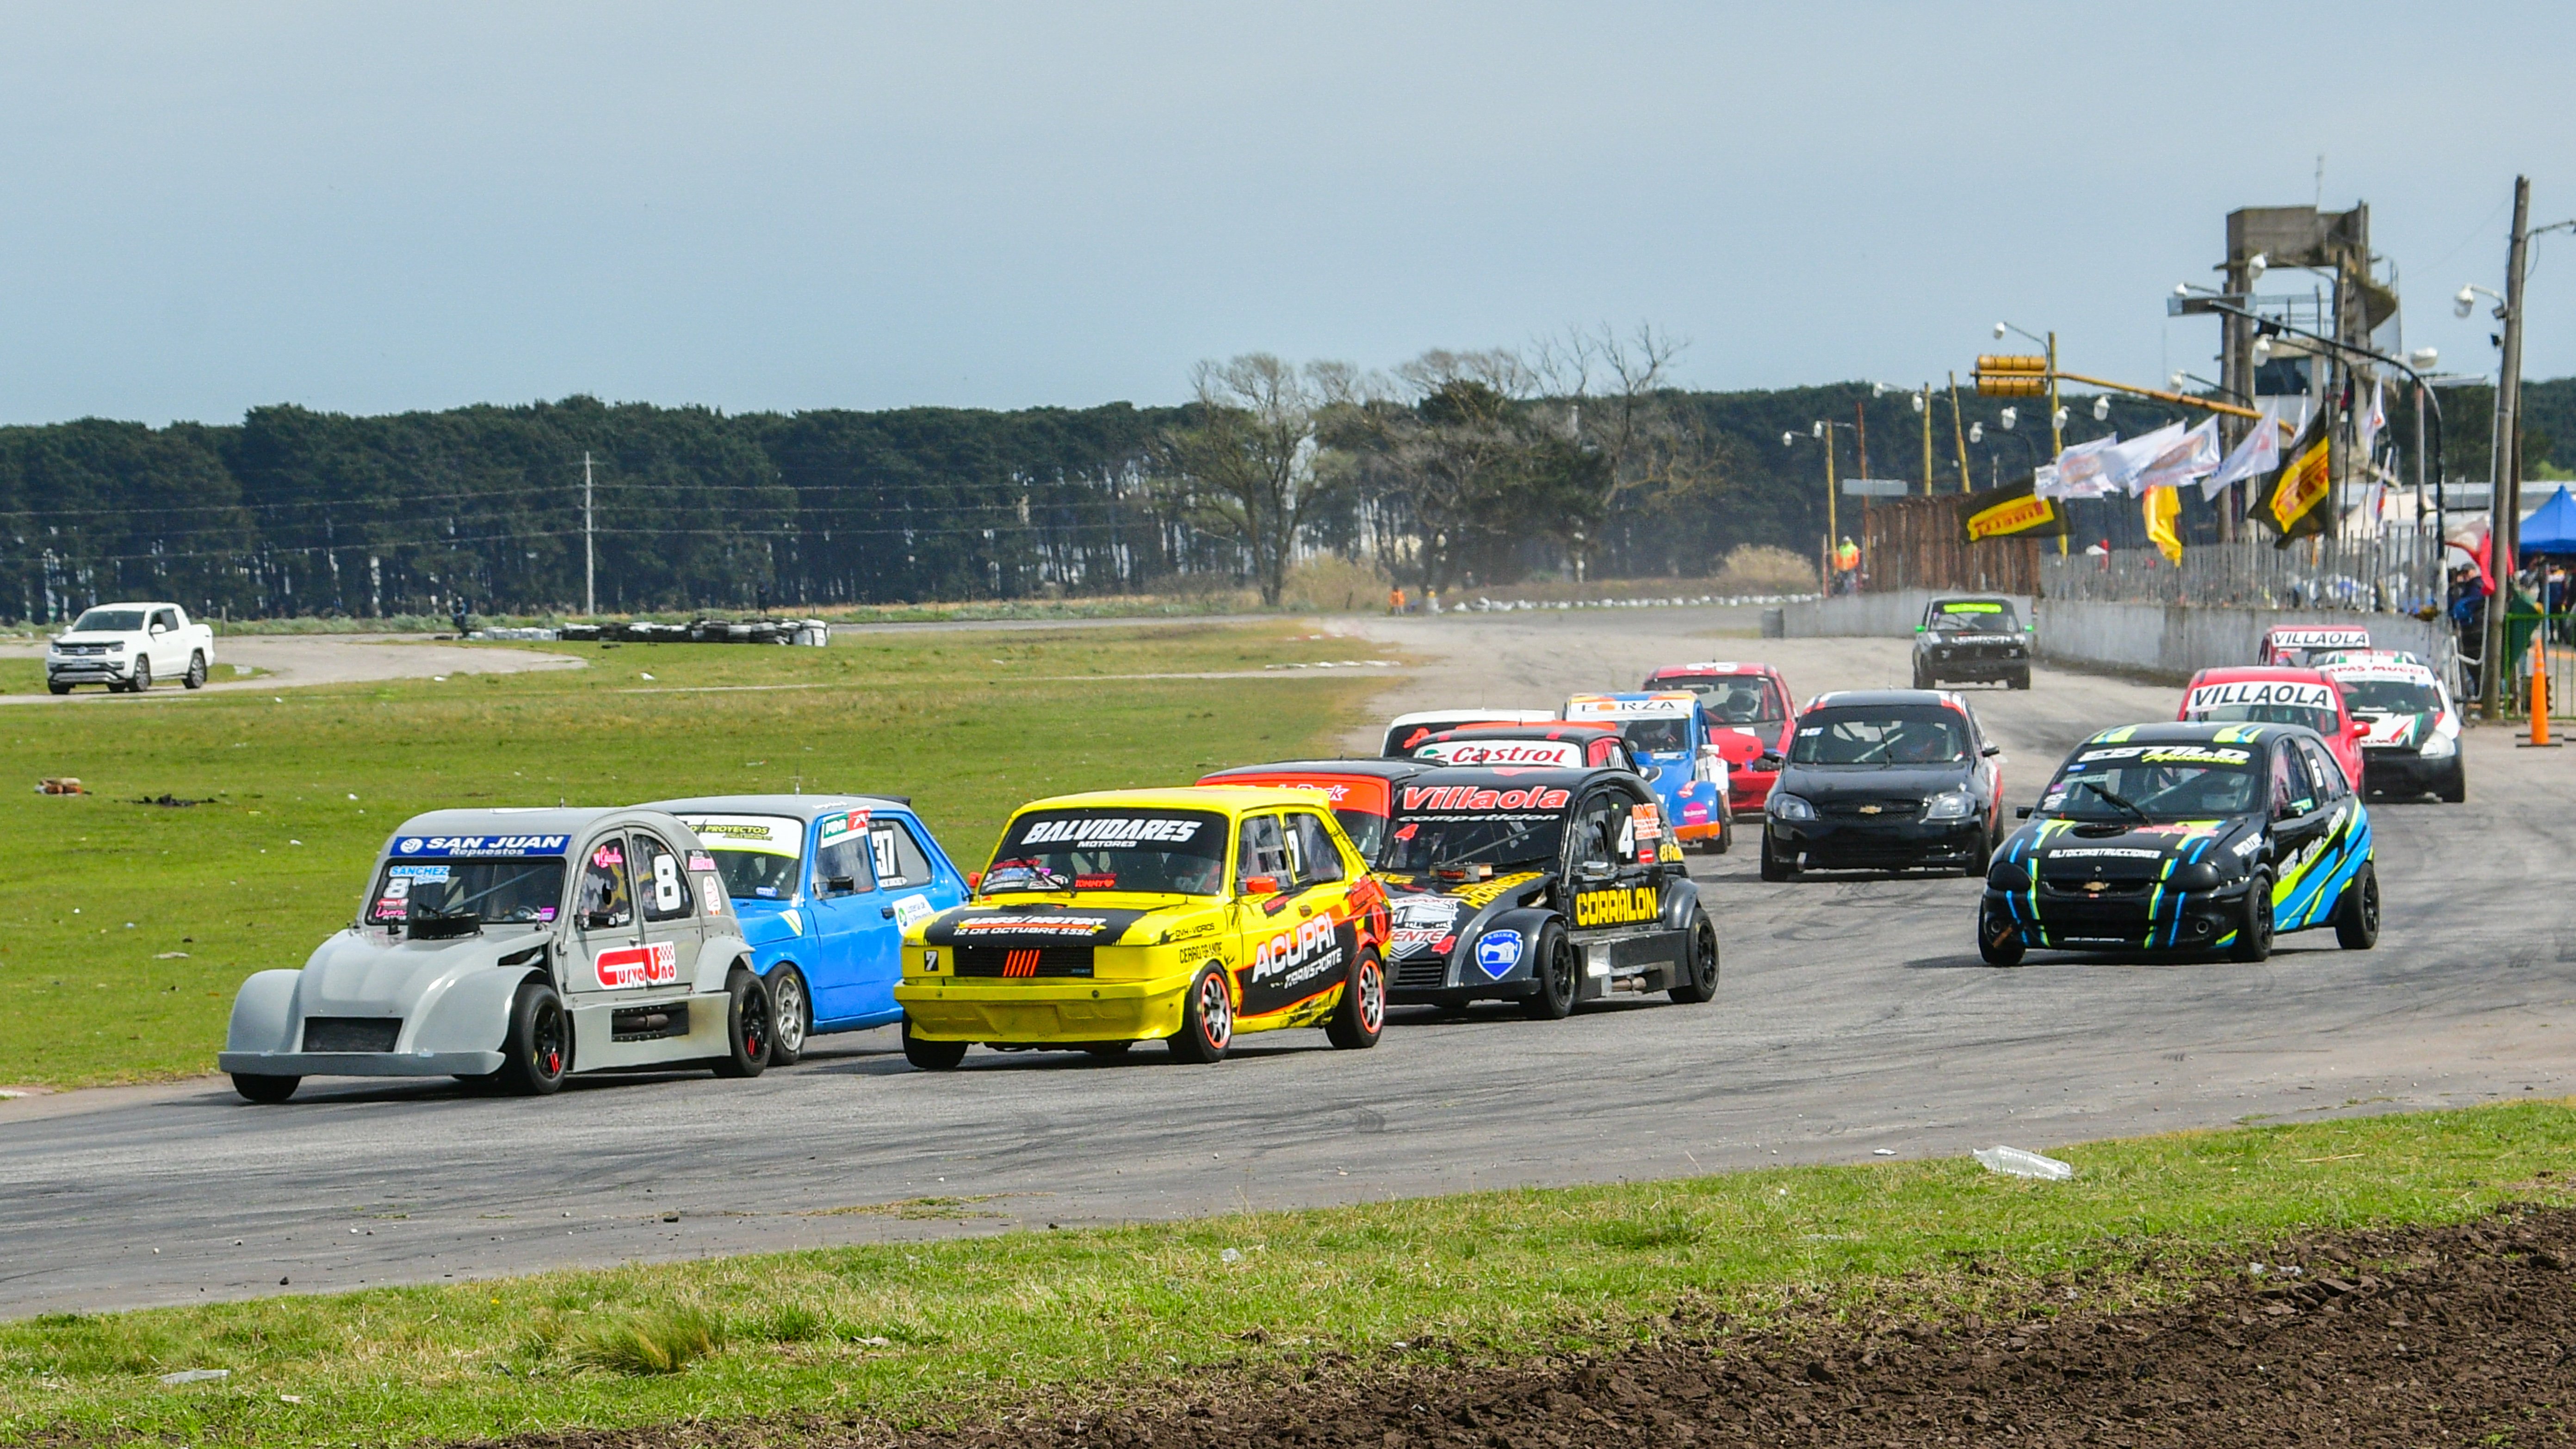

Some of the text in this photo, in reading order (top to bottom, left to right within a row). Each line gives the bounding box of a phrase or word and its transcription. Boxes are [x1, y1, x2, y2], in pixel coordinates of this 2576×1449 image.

[2274, 632, 2366, 644] VILLAOLA
[2195, 685, 2328, 707] VILLAOLA
[1452, 746, 1567, 763] Castrol
[1403, 786, 1571, 810] Villaola
[1398, 813, 1560, 823] competicion
[705, 825, 769, 835] PROYECTOS
[1020, 818, 1202, 845] BALVIDARES
[1618, 815, 1635, 859] 4
[426, 837, 484, 849] SAN
[489, 836, 564, 848] JUAN
[449, 848, 525, 857] Repuestos
[1077, 840, 1138, 848] MOTORES
[1286, 829, 1301, 873] 7
[871, 829, 895, 877] 37
[390, 866, 449, 877] SANCHEZ
[383, 878, 411, 898] 8
[653, 854, 681, 912] 8
[1576, 886, 1658, 926] CORRALON
[925, 951, 938, 971] 7
[1179, 945, 1201, 964] CERRO
[1284, 947, 1342, 989] TRANSPORTE
